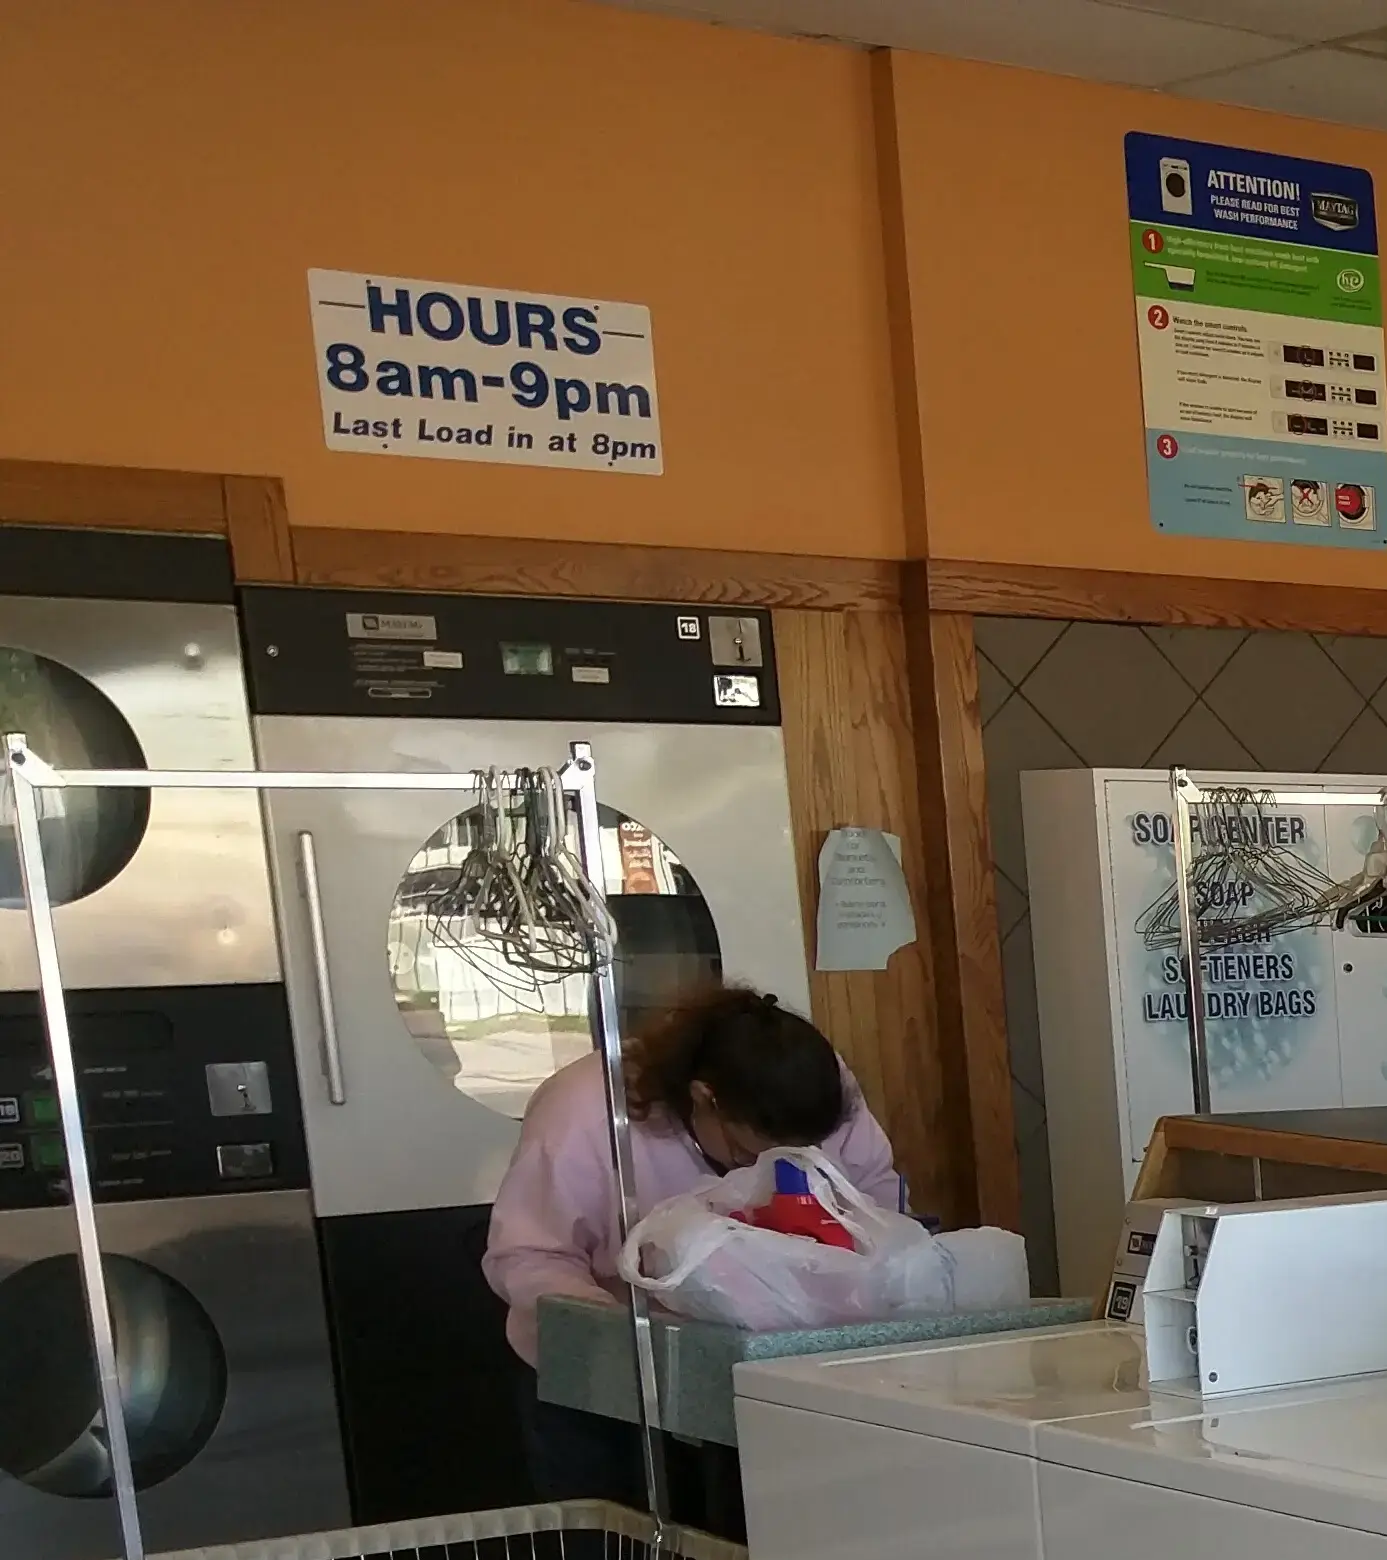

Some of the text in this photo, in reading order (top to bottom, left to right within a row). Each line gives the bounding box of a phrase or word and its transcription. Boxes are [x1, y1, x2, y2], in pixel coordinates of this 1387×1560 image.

[1207, 169, 1300, 201] ATTENTION!
[1210, 195, 1300, 217] PLEASE READ FOR BEST
[1213, 209, 1299, 230] WASH PERFORMANCE
[1317, 200, 1354, 216] MAYTAG
[1148, 233, 1156, 251] 1
[366, 285, 601, 356] HOURS
[1154, 309, 1163, 326] 2
[325, 343, 651, 420] 8am-9pm
[333, 411, 657, 461] Last Load in at 8pm
[1163, 439, 1172, 456] 3
[681, 622, 697, 633] 18
[1135, 813, 1305, 845] SOP CENTER
[1195, 881, 1254, 908] SOAP
[1164, 953, 1293, 982] SFTENERS
[1146, 990, 1316, 1020] LAUDRY BAGS
